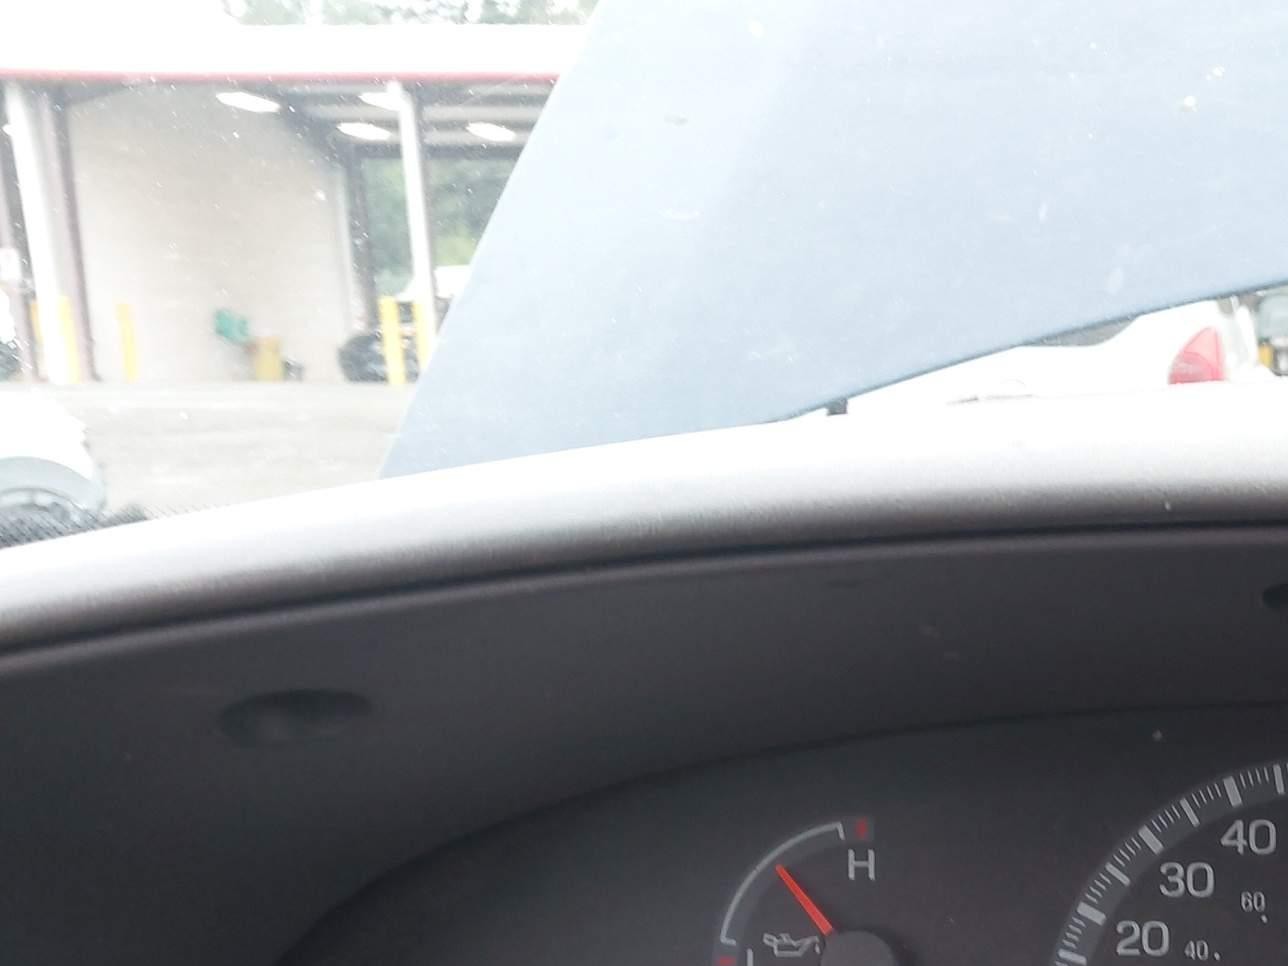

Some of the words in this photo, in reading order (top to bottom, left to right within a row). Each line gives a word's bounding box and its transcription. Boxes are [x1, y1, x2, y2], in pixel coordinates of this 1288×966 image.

[1221, 819, 1277, 855] 40
[847, 849, 876, 881] H
[1160, 862, 1215, 898] 30
[1241, 892, 1265, 913] 60
[1116, 920, 1169, 957] 20
[1184, 940, 1209, 960] 40
